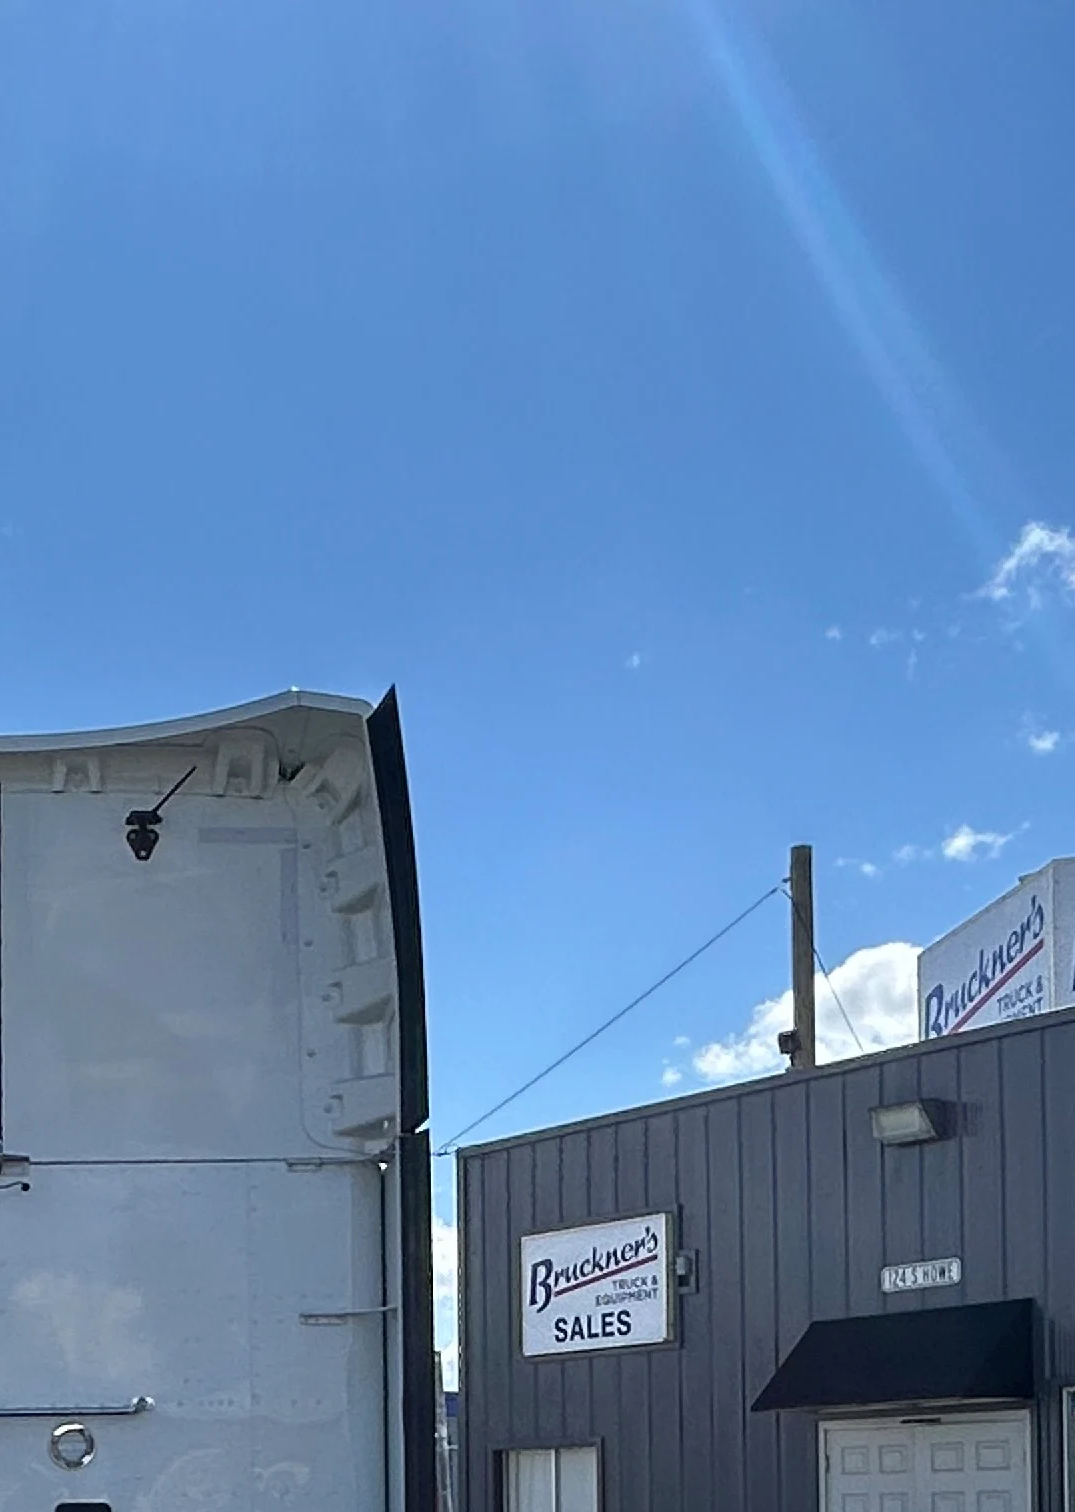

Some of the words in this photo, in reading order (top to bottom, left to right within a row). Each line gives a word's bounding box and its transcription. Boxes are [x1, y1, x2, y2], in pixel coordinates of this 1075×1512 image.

[925, 894, 1045, 1039] Bruckner's
[997, 982, 1032, 1014] TRUCK
[528, 1225, 658, 1314] Bruckner's
[612, 1277, 647, 1290] TRUCK
[650, 1275, 658, 1286] &
[595, 1288, 658, 1307] EQUIPMENT
[554, 1310, 632, 1343] SALES
